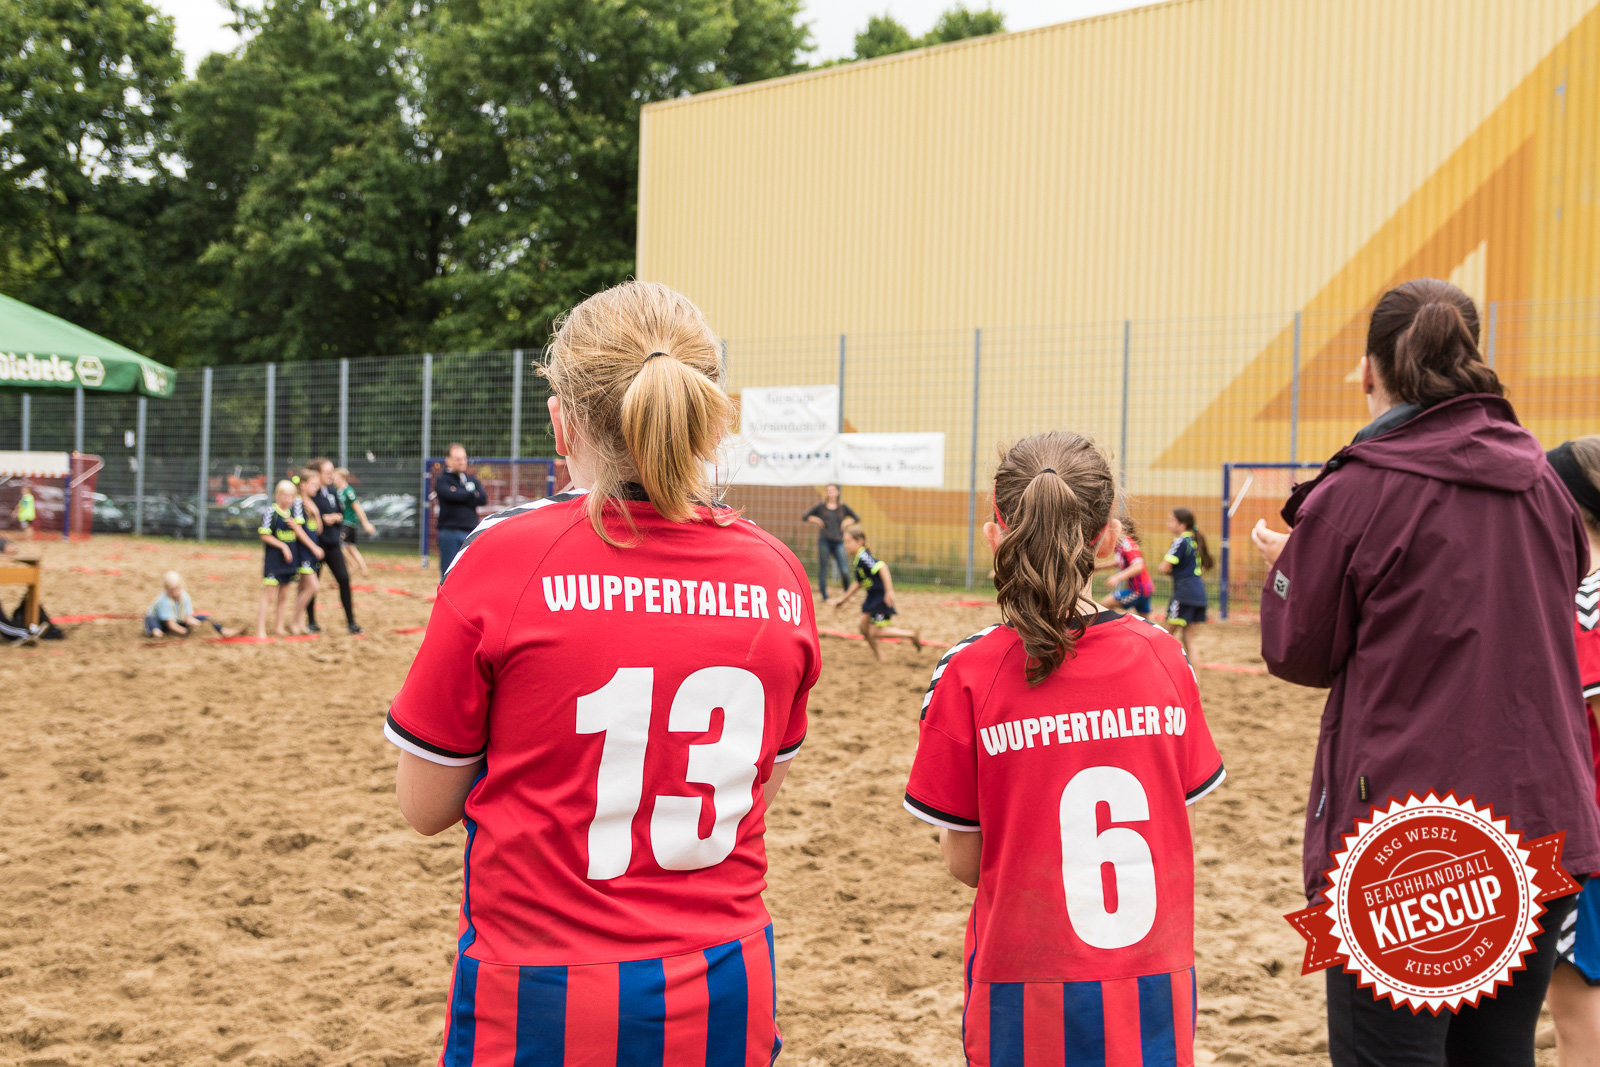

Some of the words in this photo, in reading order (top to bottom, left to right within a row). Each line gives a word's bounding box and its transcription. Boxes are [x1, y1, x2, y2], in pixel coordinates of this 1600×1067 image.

[542, 574, 769, 619] WUPPERTALER
[575, 666, 766, 880] 13
[979, 705, 1162, 756] WUPPERTALER
[1059, 766, 1157, 949] 6
